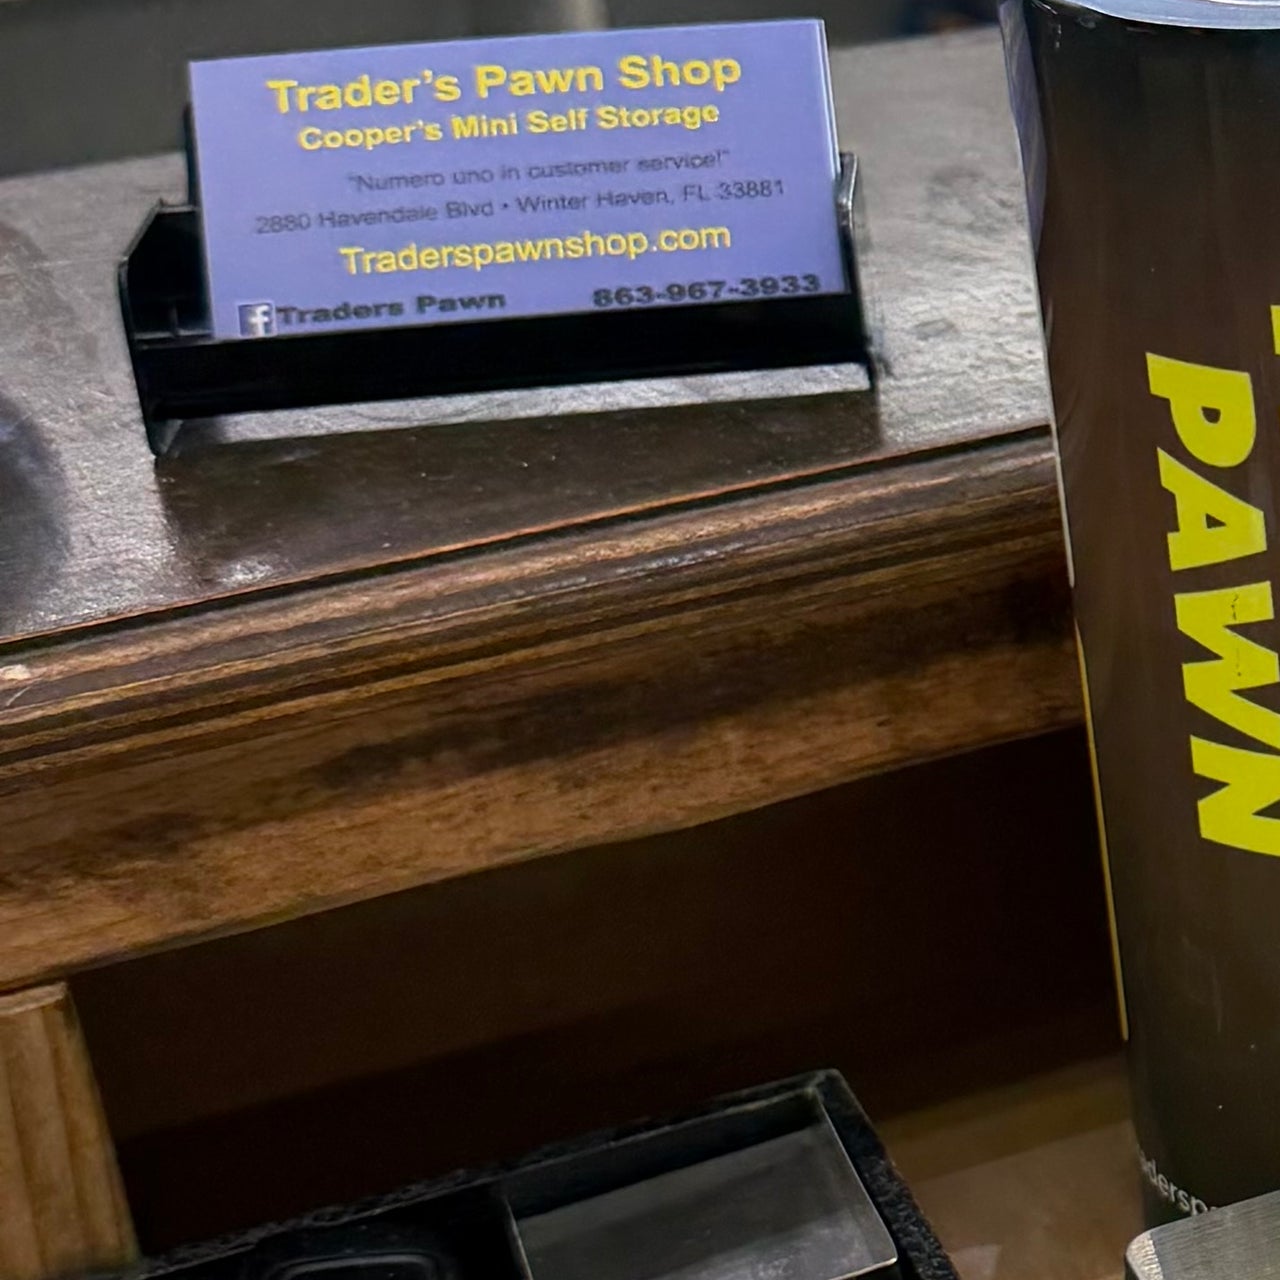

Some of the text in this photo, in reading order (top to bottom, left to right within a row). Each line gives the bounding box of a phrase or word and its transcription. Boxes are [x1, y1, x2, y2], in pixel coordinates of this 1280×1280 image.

[266, 54, 742, 114] Trader's Pawn Shop
[299, 104, 720, 150] Cooper's Mini Self Storage
[452, 168, 495, 185] uno
[500, 165, 521, 181] in
[527, 158, 630, 180] customer
[445, 200, 495, 219] Blvd
[515, 194, 588, 214] Winter
[683, 184, 711, 202] FL
[339, 226, 732, 276] Traderspawnshop.com
[275, 302, 404, 325] Traders
[415, 293, 506, 315] Pawn
[592, 273, 821, 308] 863-967-3933
